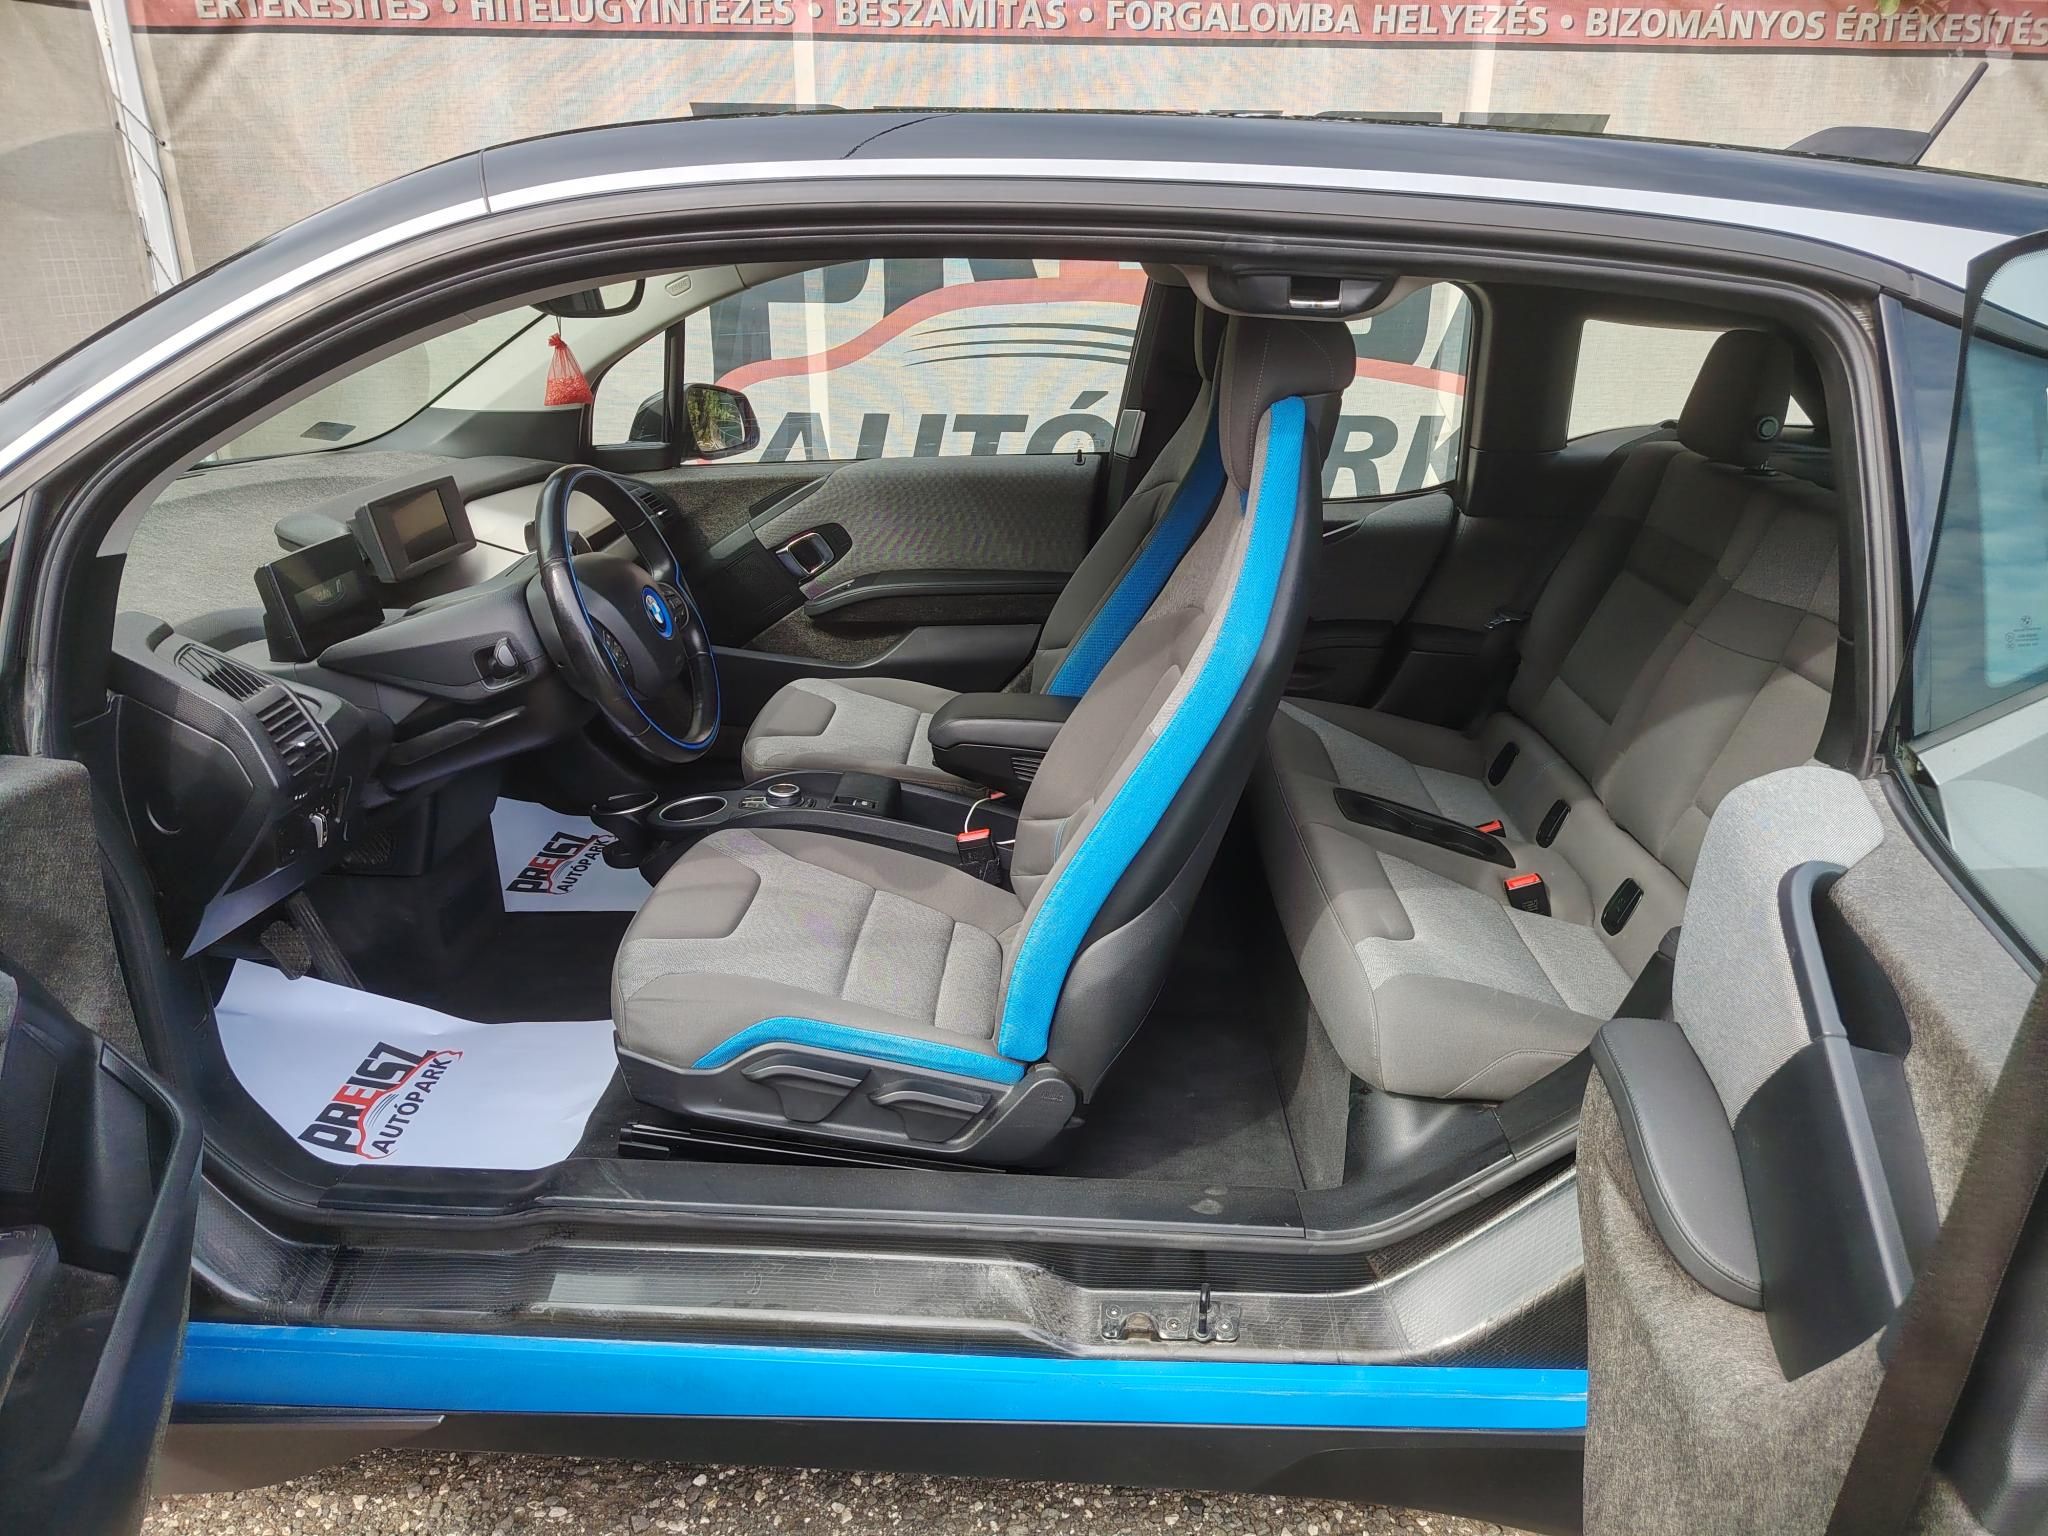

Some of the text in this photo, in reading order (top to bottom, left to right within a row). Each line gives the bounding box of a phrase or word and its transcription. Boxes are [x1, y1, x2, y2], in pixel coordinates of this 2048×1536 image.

[1106, 1, 1361, 33] FORGALOMBA
[1372, 0, 1548, 36] HELYEZÉS
[1585, 3, 1826, 41] BIZOMÁNYOS
[506, 831, 599, 894] PREISZ
[297, 1041, 438, 1154] PREISZ
[371, 1057, 453, 1155] AUTÓPARK
